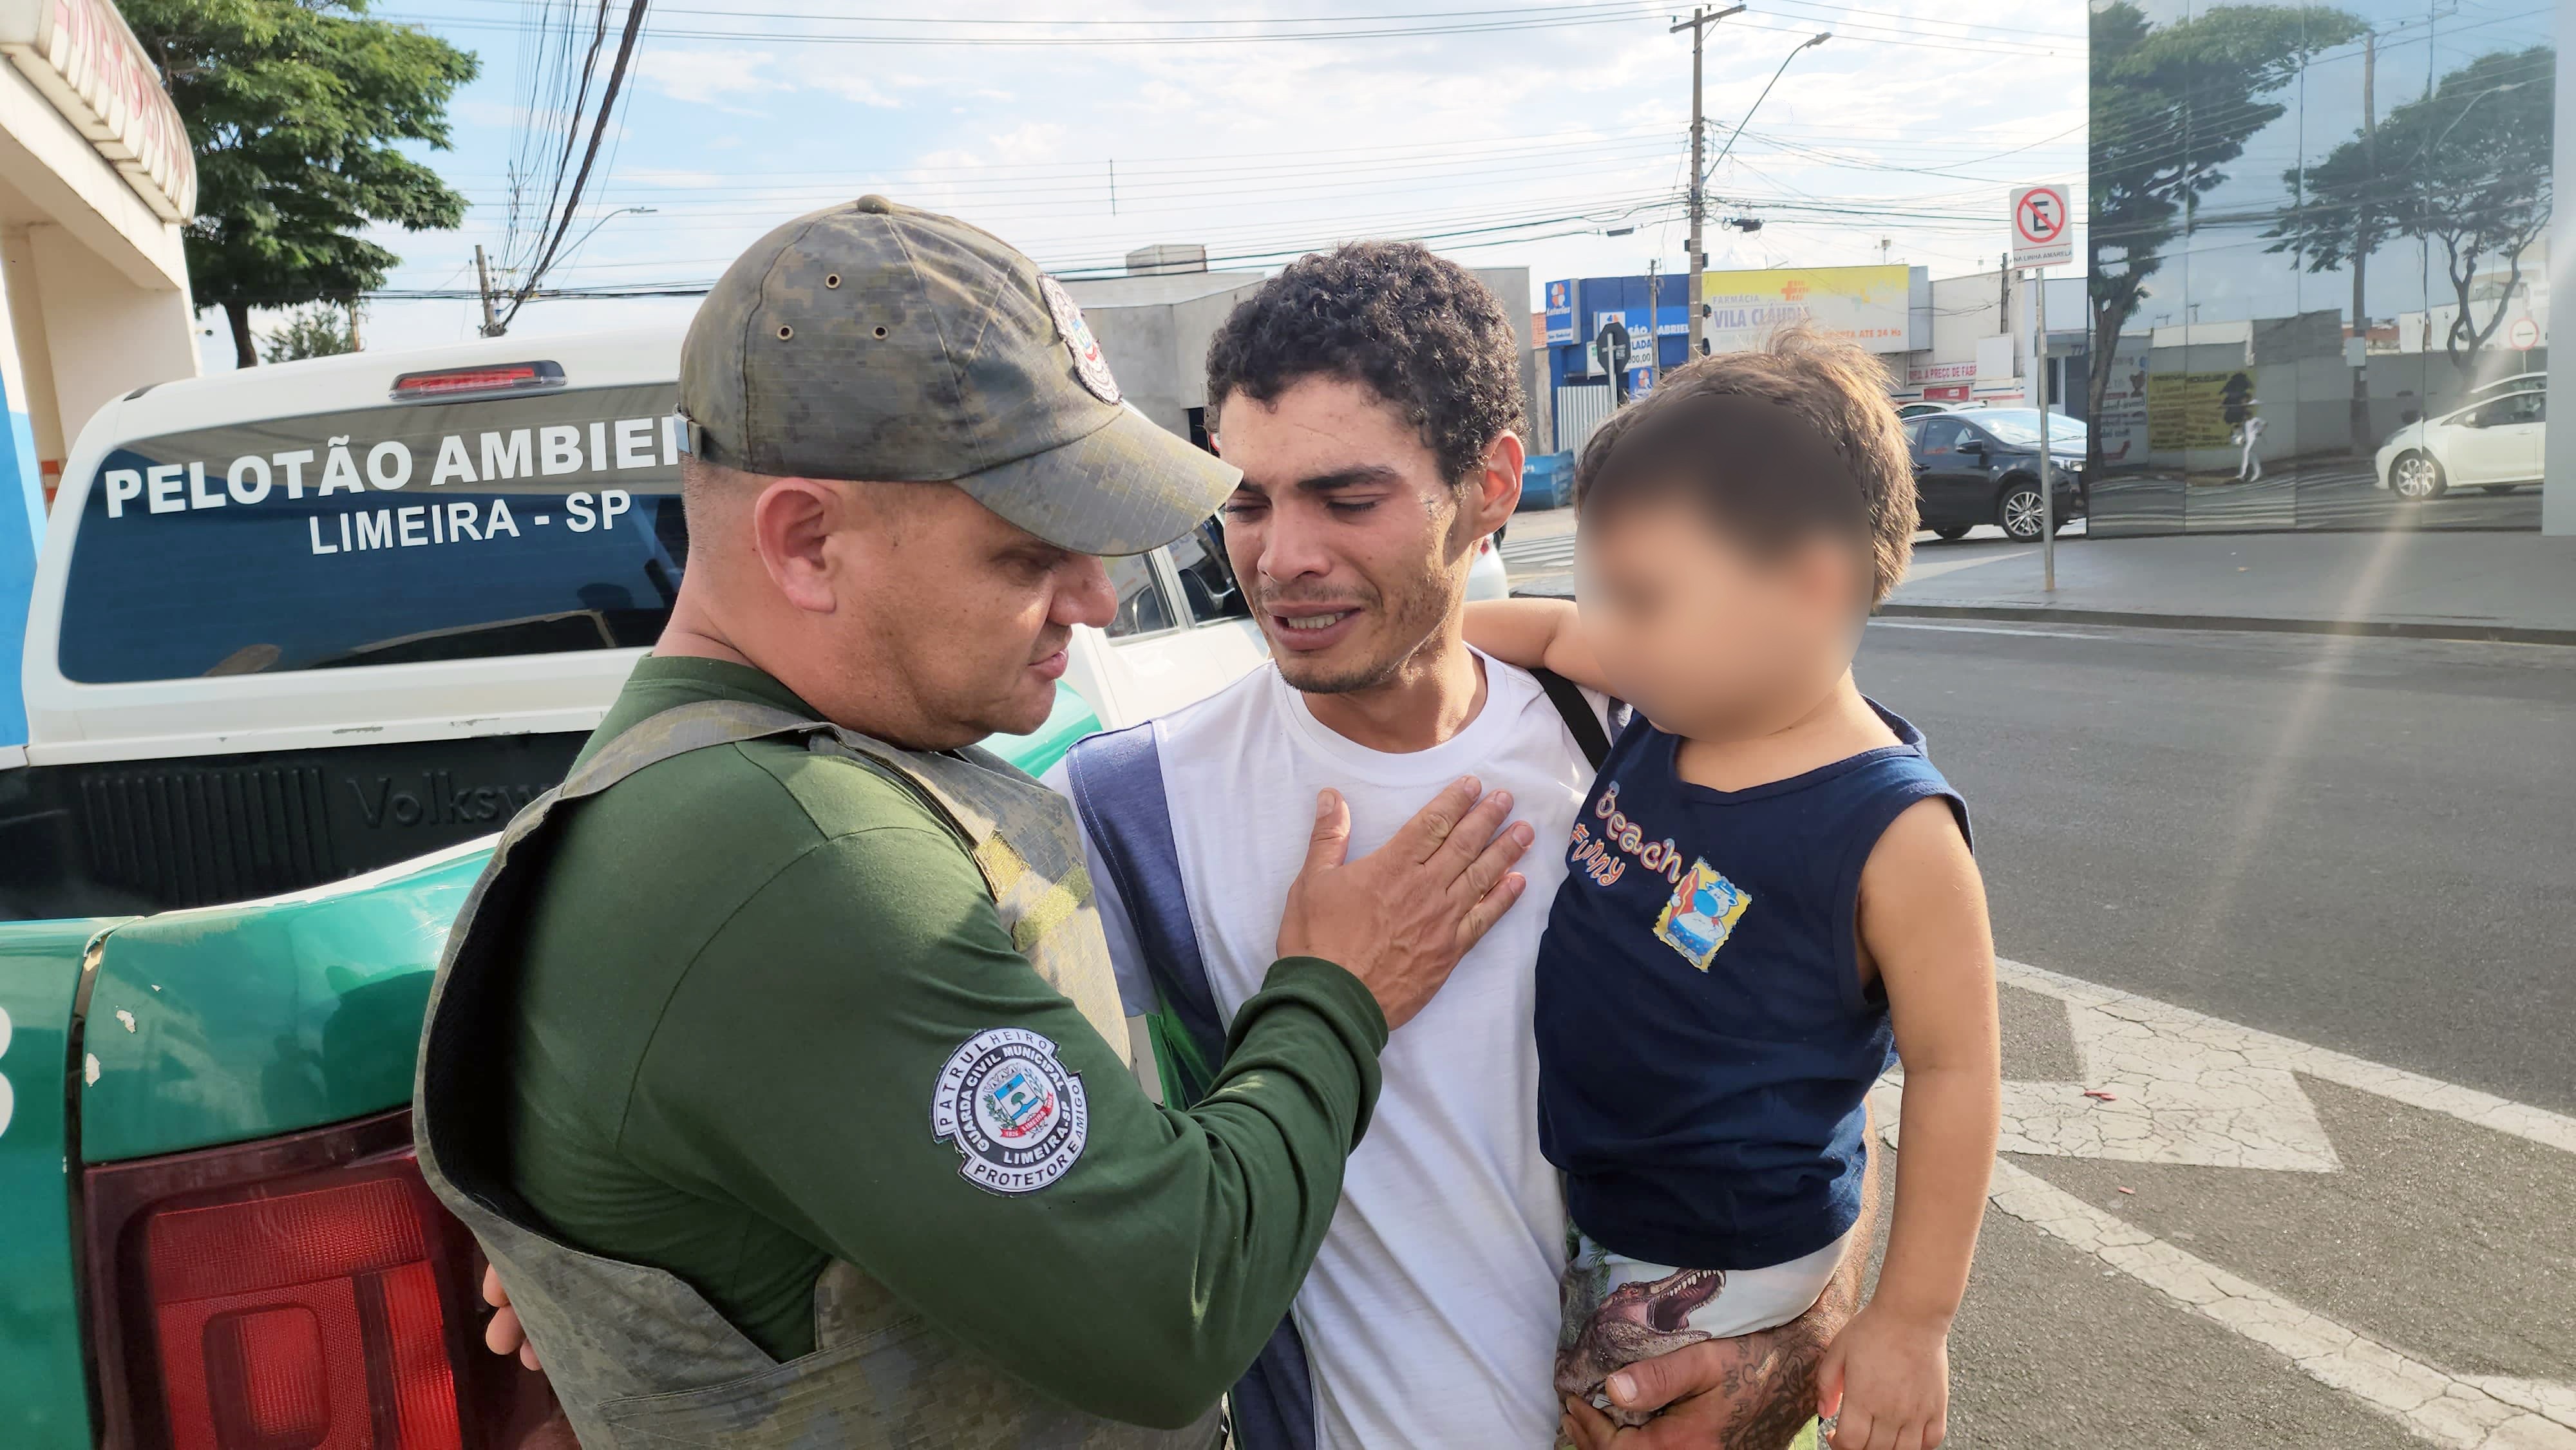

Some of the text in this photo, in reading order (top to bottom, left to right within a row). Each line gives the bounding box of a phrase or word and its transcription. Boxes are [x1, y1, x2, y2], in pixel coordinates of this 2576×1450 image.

[1712, 294, 1760, 305] FARMÁCIA
[1714, 309, 1747, 328] VILA
[1952, 366, 1960, 377] DE
[105, 417, 679, 518] PELOTÃO AMBIE
[309, 489, 631, 555] LIMEIRA - SP
[939, 1031, 1046, 1125] PATRULHEIRO
[960, 1046, 1065, 1152] GUARDA CIVIL MUNICIPAL
[974, 1084, 1084, 1186] PROTETOR E AMIGO
[1003, 1101, 1072, 1165] LIMEIRA-SP
